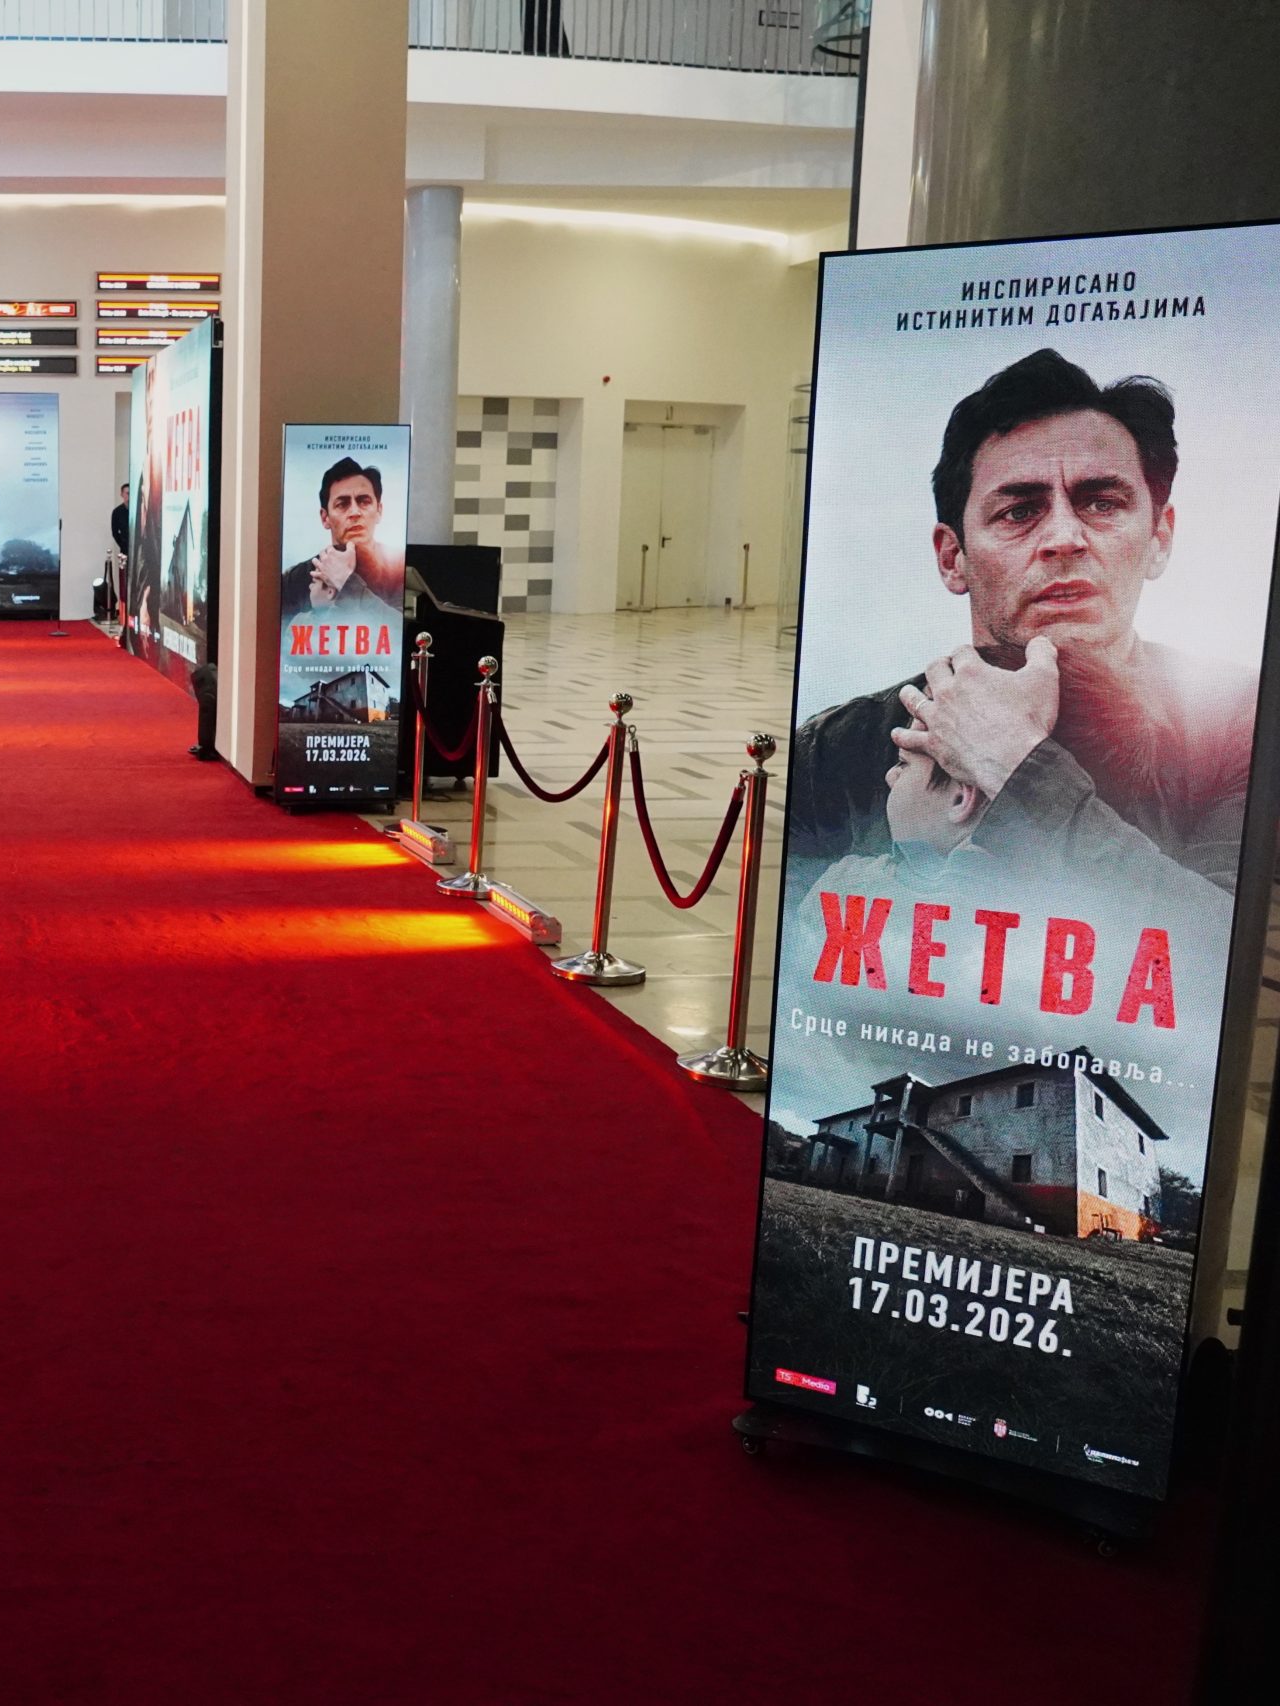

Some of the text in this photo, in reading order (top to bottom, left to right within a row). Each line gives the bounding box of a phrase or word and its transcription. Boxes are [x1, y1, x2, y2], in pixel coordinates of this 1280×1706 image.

[961, 271, 1137, 301] ИНСПИРИСАНО
[896, 296, 1206, 332] ИСТИНИТИМ ДОГАЂАЈИМА
[290, 624, 391, 655] ЖЕТВА
[305, 749, 370, 761] 17.03.2026.
[306, 735, 370, 748] ПРЕМИЈЕРА
[813, 891, 1177, 1029] ЖЕТВА
[790, 1007, 1196, 1089] Срце никада не заборавља...
[852, 1236, 1074, 1315] ПРЕМИЈЕРА
[848, 1277, 1073, 1357] 17.03.2026.
[801, 1377, 829, 1391] Media
